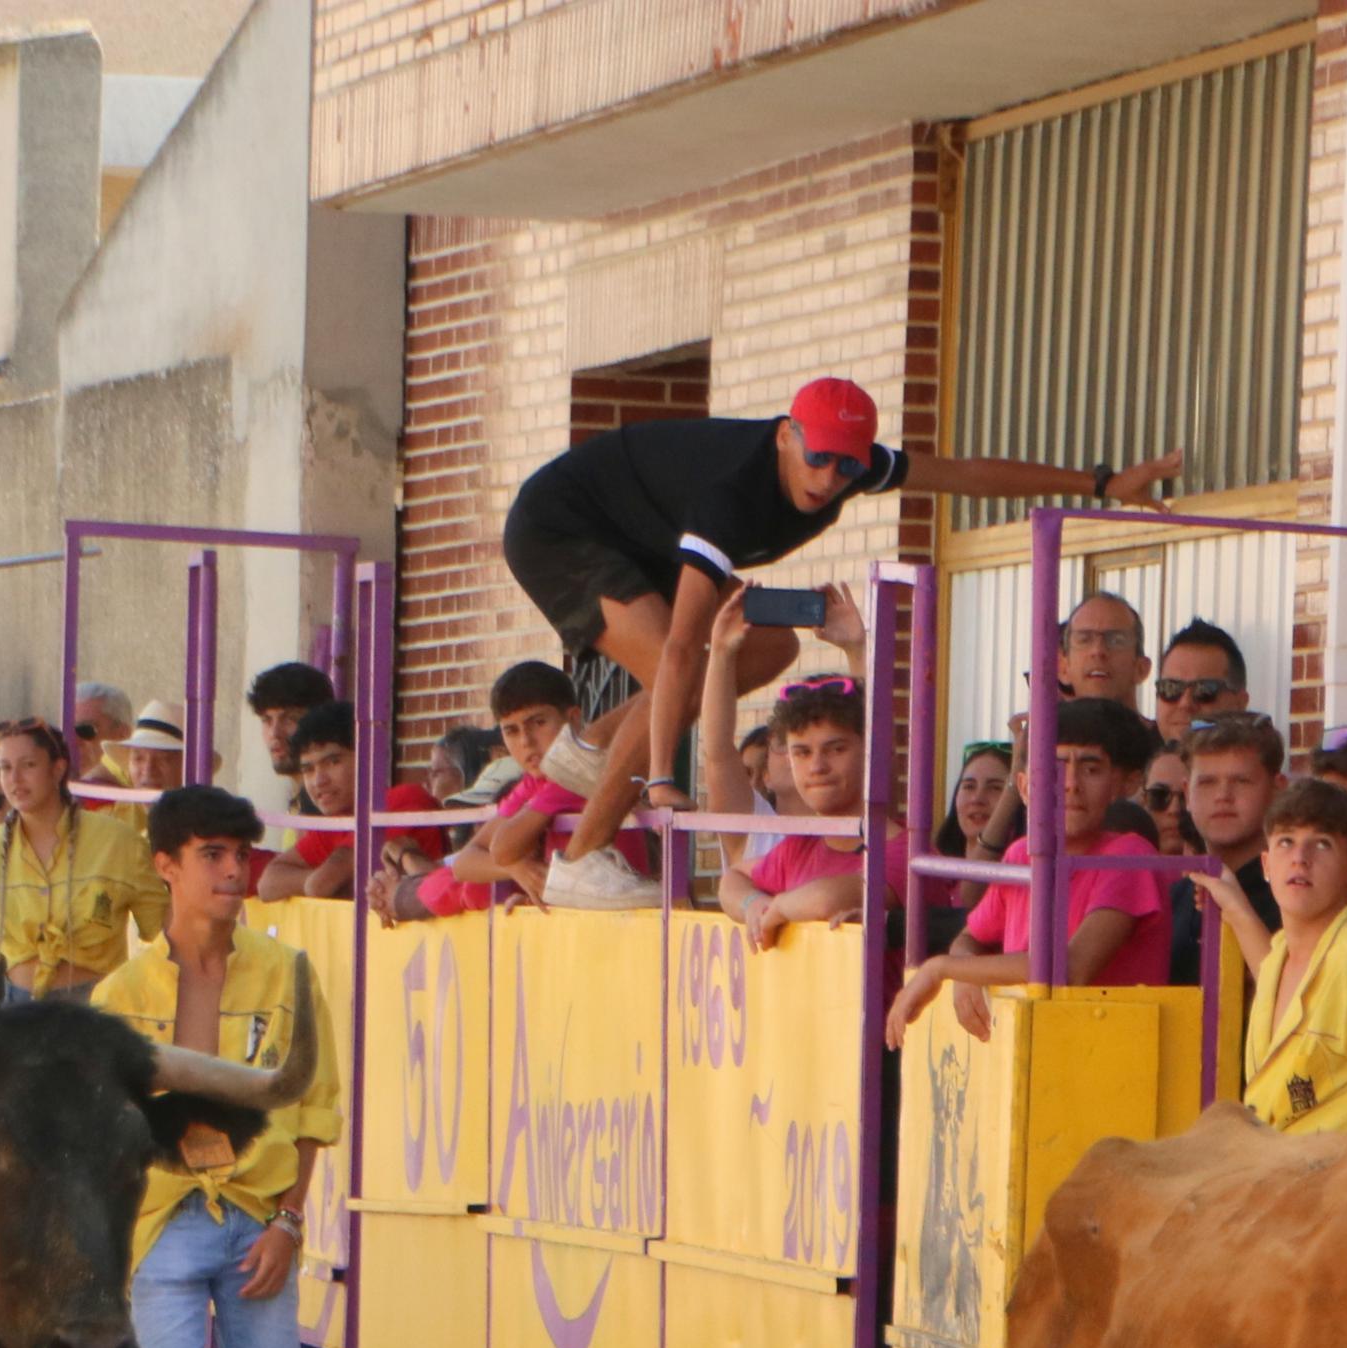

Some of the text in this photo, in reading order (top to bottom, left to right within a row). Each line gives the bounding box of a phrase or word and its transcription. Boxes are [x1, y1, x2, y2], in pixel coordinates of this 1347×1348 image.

[403, 933, 463, 1193] 50
[677, 922, 746, 1069] 1969
[783, 1119, 852, 1269] 2019
